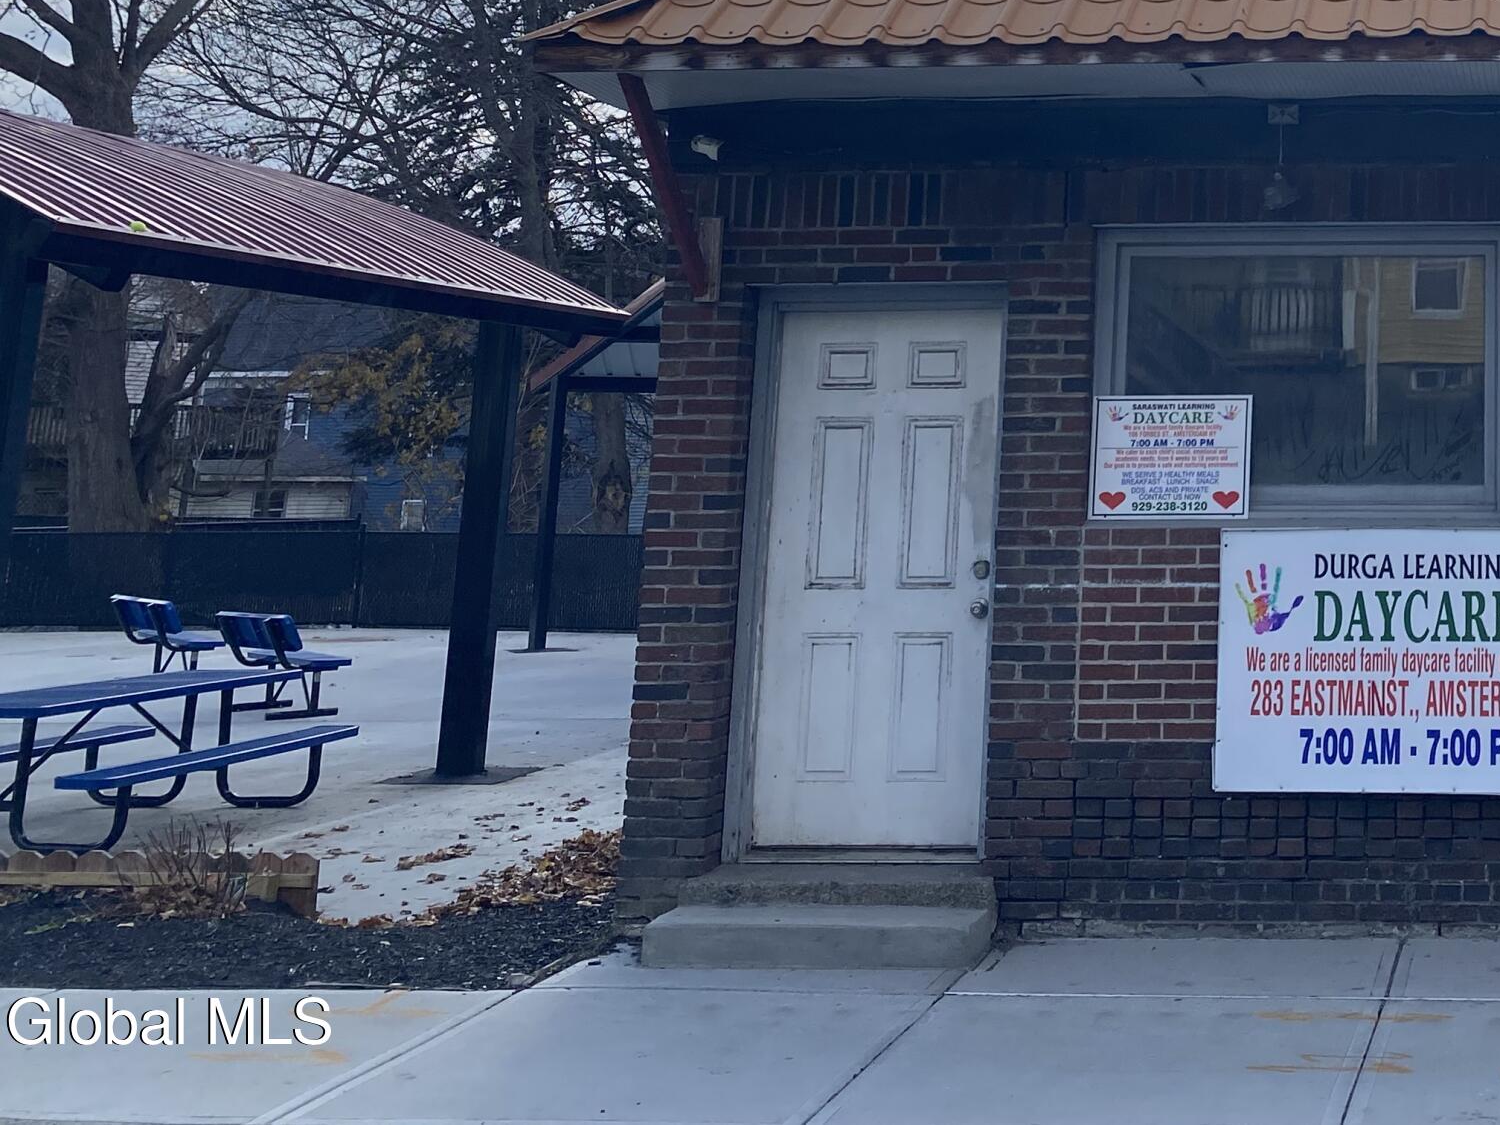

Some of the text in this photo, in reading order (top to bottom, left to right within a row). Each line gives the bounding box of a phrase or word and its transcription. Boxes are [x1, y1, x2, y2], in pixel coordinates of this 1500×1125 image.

[1132, 403, 1216, 411] SARASWATI LEARNING
[1132, 411, 1214, 425] DAYCARE
[1130, 439, 1150, 447] 7:00
[1154, 439, 1168, 447] AM
[1177, 439, 1197, 447] 7:00
[1200, 439, 1214, 447] PM
[1132, 502, 1208, 511] 929-238-3120
[1314, 553, 1395, 579] DURGA
[1246, 647, 1267, 671] We
[1270, 653, 1290, 672] are
[1294, 654, 1300, 672] a
[1305, 647, 1356, 672] licensed
[1360, 647, 1398, 677] family
[1402, 648, 1450, 678] daycare
[1454, 649, 1496, 678] facility
[1250, 680, 1284, 716] 283
[1300, 729, 1354, 765] 7:00
[1361, 729, 1400, 765] AM
[1410, 746, 1417, 757] -
[1427, 729, 1480, 765] 7:00
